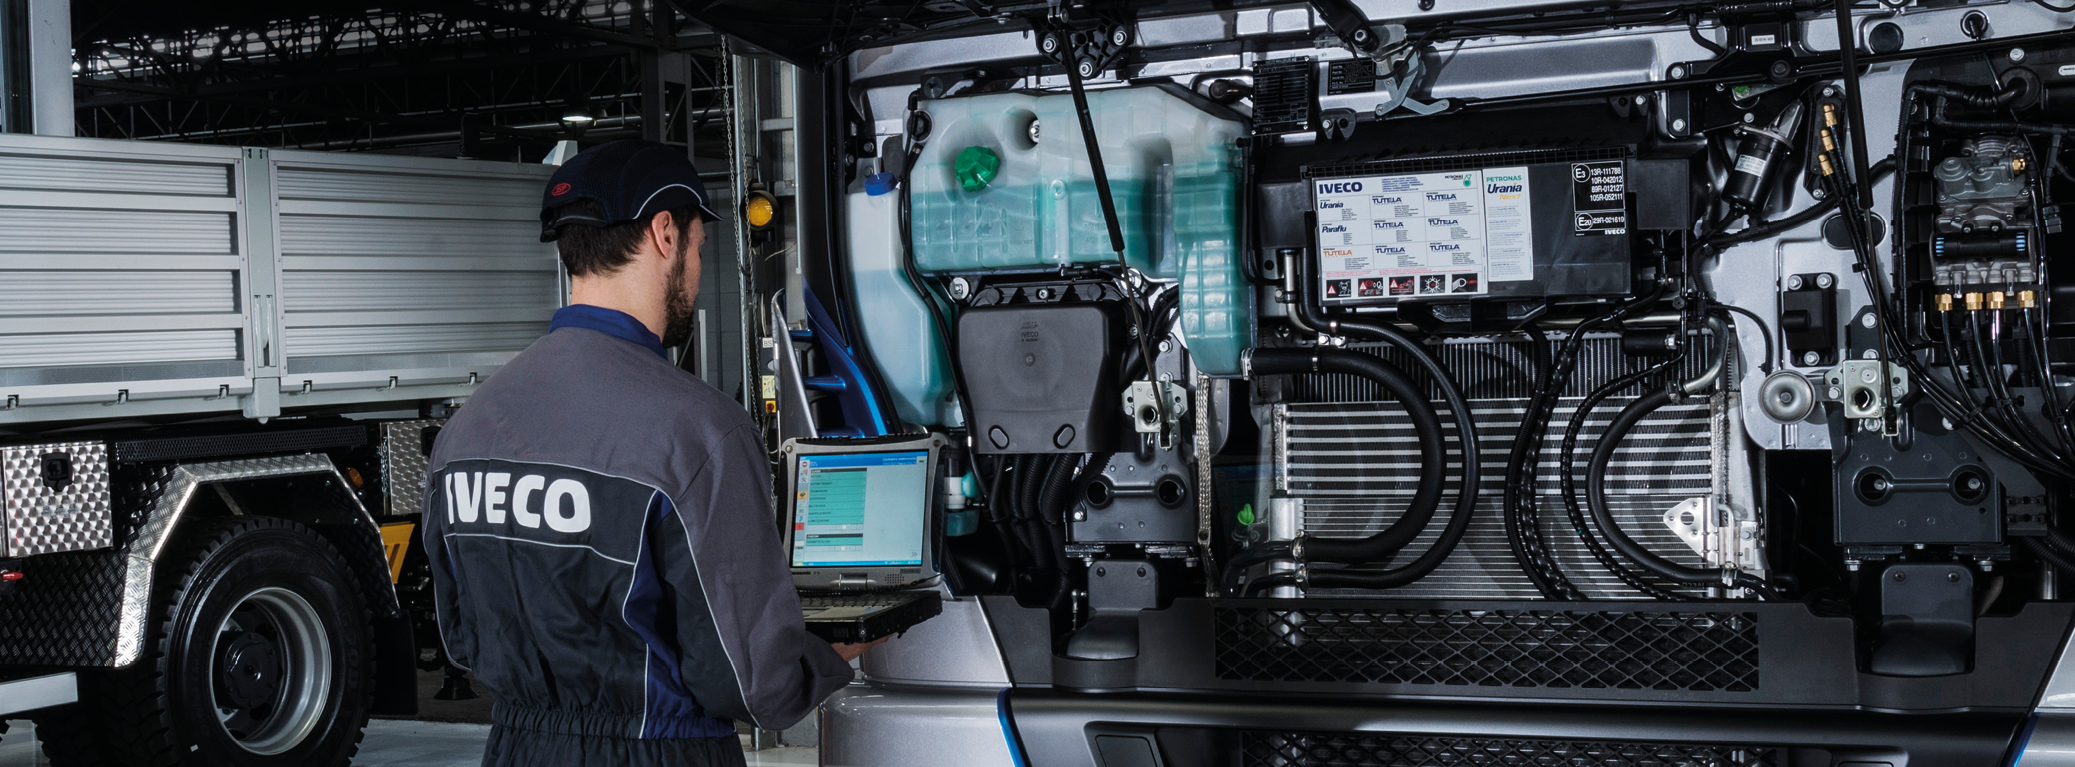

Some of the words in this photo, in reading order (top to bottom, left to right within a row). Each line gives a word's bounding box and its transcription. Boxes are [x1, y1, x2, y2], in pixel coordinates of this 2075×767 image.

[1486, 175, 1522, 183] PETRONAS
[1319, 181, 1363, 195] IVECO
[1487, 182, 1522, 194] Urania
[1426, 193, 1457, 201] TUTELA
[1499, 193, 1522, 201] Next
[1319, 200, 1344, 209] Urania
[1374, 221, 1404, 229] TUTELA
[1428, 219, 1459, 227] TUTELA
[1321, 225, 1347, 233] Paraflu
[1323, 249, 1353, 257] TUTELA
[445, 471, 592, 533] IVECO
